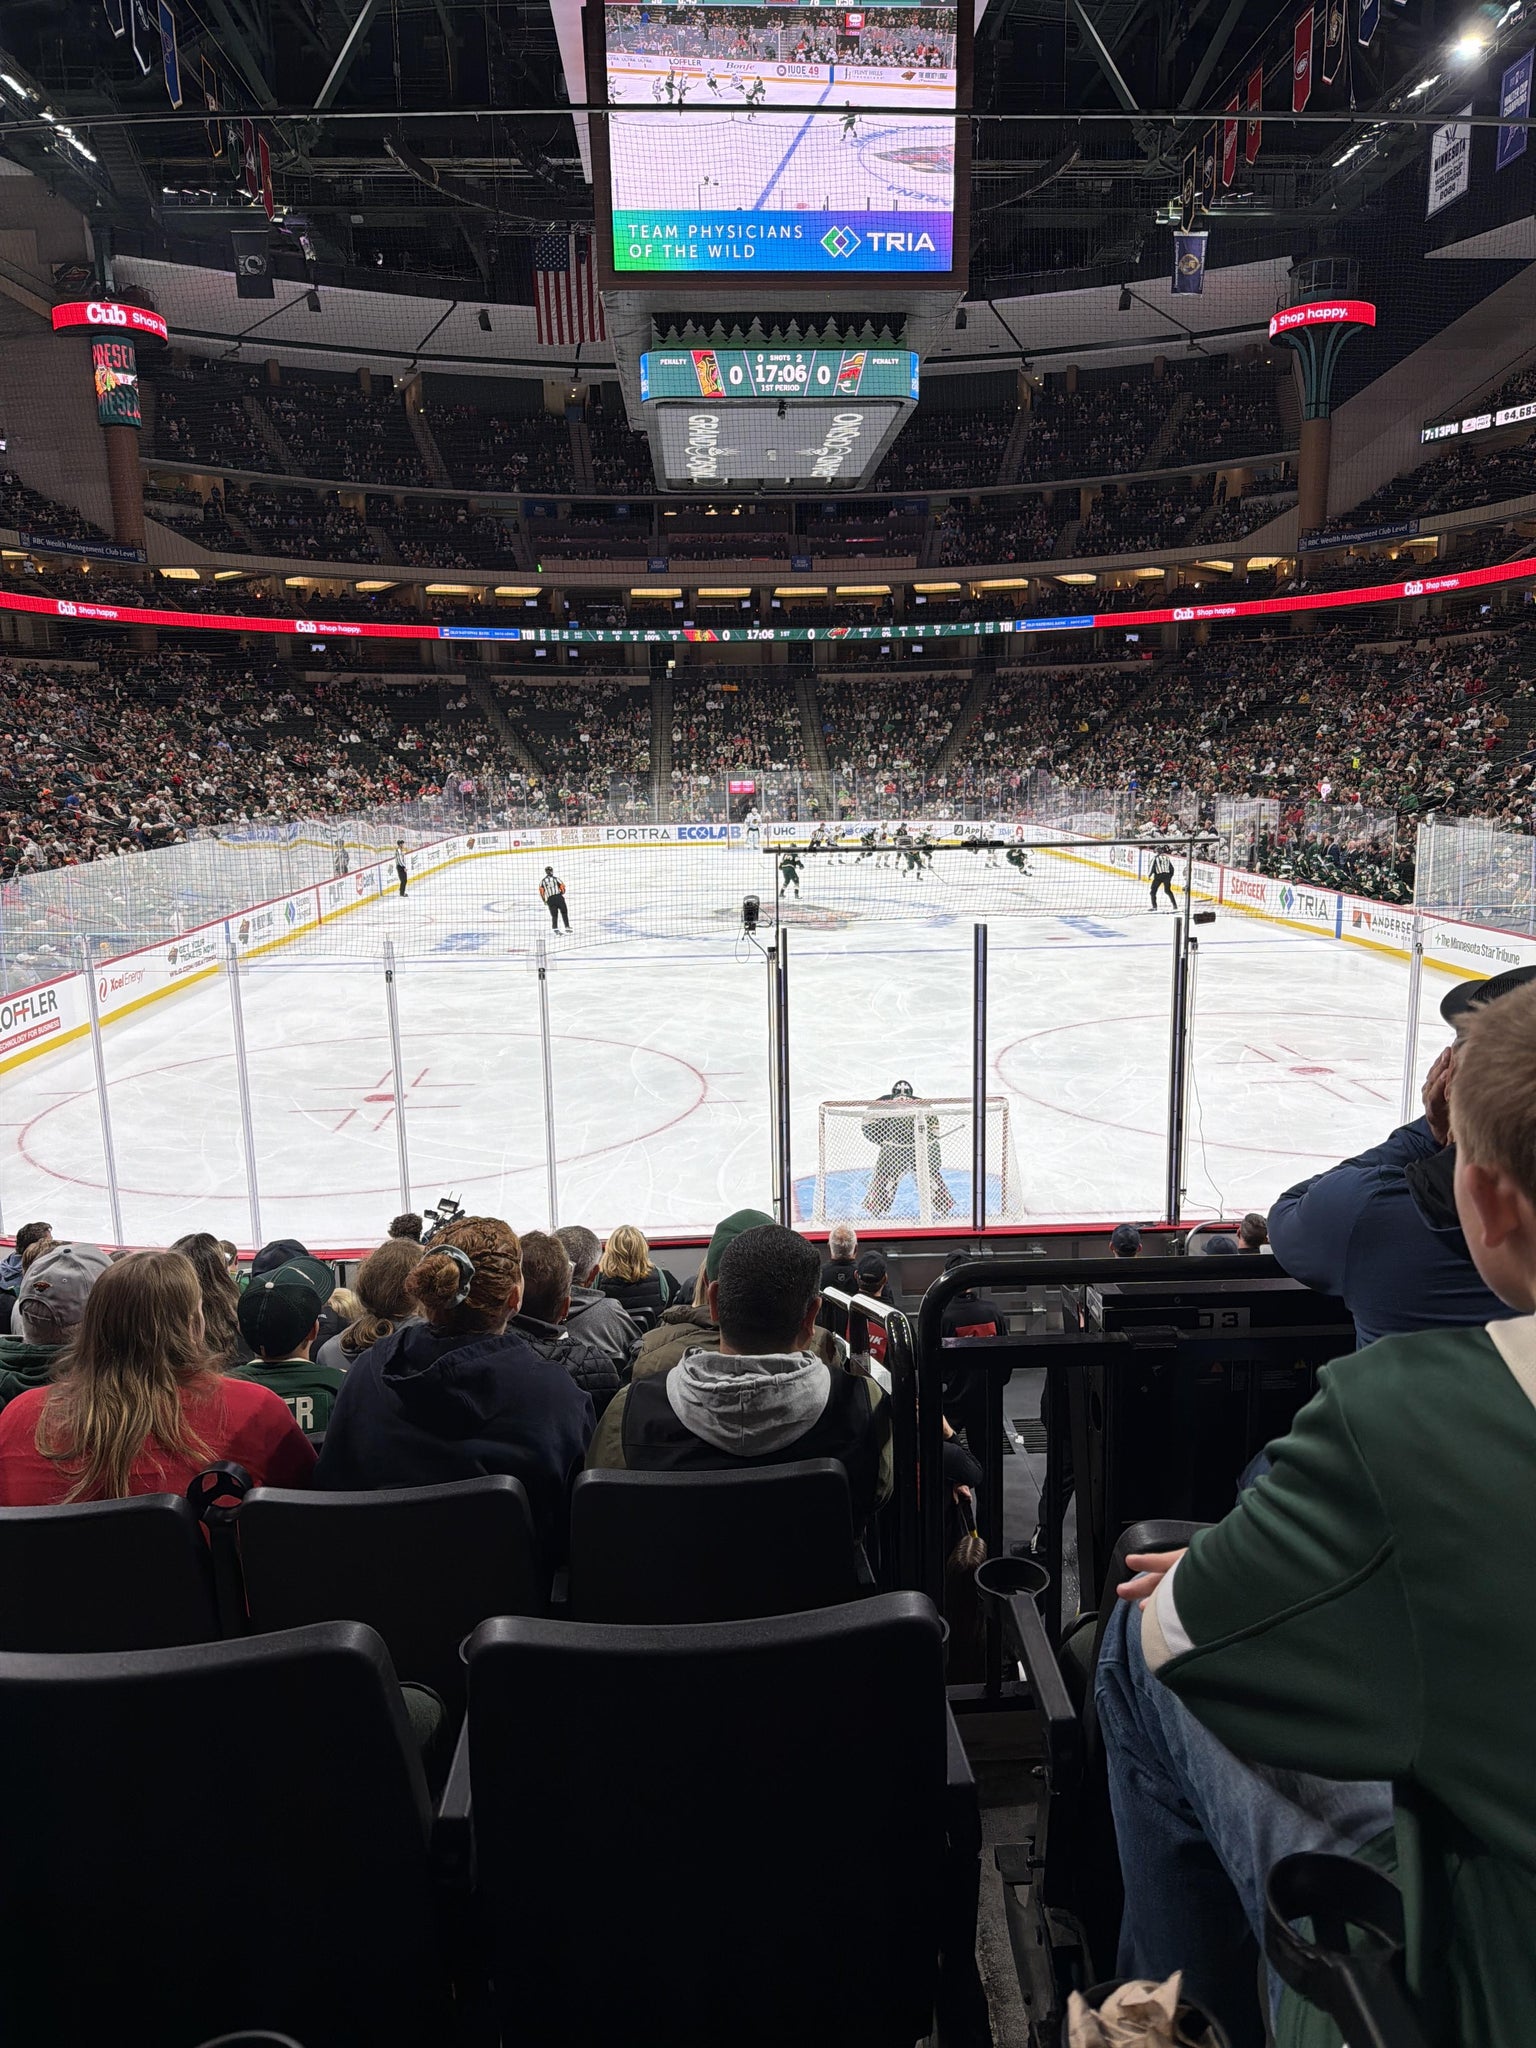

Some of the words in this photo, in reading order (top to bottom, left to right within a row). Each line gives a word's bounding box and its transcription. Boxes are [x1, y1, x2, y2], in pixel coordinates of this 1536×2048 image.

[669, 58, 702, 67] LOFFLER
[726, 62, 756, 71] Bonfe
[808, 66, 819, 75] 49
[628, 225, 678, 239] TEAM
[688, 224, 803, 239] PHYSICIANS
[866, 232, 936, 252] TRIA
[629, 244, 653, 258] OF
[662, 244, 698, 258] THE
[707, 244, 755, 258] WILD
[86, 303, 126, 325] Cub
[132, 312, 158, 330] Shop
[1279, 312, 1305, 326] Shop
[1307, 307, 1348, 320] happy.
[757, 354, 764, 363] 0
[770, 354, 791, 362] SHOTS
[796, 353, 803, 363] 2
[729, 365, 743, 385] 0
[755, 364, 807, 383] 17:06
[817, 365, 831, 385] 0
[761, 384, 773, 392] 1ST
[775, 384, 800, 392] PERIOD
[688, 414, 720, 447] GRAND
[1424, 422, 1459, 441] 7:13PM
[1320, 535, 1341, 544] Wealth
[1341, 530, 1378, 541] Management
[1378, 527, 1391, 535] Club
[1391, 524, 1408, 533] Level
[32, 537, 45, 546] RBC
[45, 539, 66, 548] Wealth
[66, 542, 105, 554] Management
[105, 548, 119, 556] Club
[120, 550, 136, 558] Level
[1404, 581, 1424, 595] Cub
[1425, 581, 1440, 590] Shop
[58, 601, 77, 616] Cub
[78, 606, 96, 617] Shop
[96, 607, 119, 619] happy.
[1173, 607, 1194, 620] Cub
[1197, 608, 1214, 616] Shop
[1214, 607, 1237, 616] happy.
[295, 620, 317, 633] Cub
[319, 624, 338, 633] Shop
[338, 624, 362, 634] happy.
[746, 629, 775, 640] 17:06
[807, 628, 815, 640] 0
[999, 620, 1013, 633] TOI
[521, 629, 535, 641] TOI
[722, 629, 731, 641] 0
[606, 828, 670, 841] FORTRA
[677, 826, 741, 840] ECOLAB
[773, 826, 796, 836] UHC
[1231, 876, 1266, 903] SEATGEEK
[1297, 893, 1329, 920] TRIA
[1372, 915, 1414, 936] ANDERSE
[1441, 933, 1450, 946] The
[1450, 936, 1480, 955] Minnesota
[1480, 945, 1495, 959] Star
[1495, 947, 1520, 965] Tribune
[0, 989, 58, 1033] OFFLER
[27, 1028, 38, 1040] FOR
[38, 1019, 60, 1037] BUSINESS
[284, 1396, 314, 1429] R
